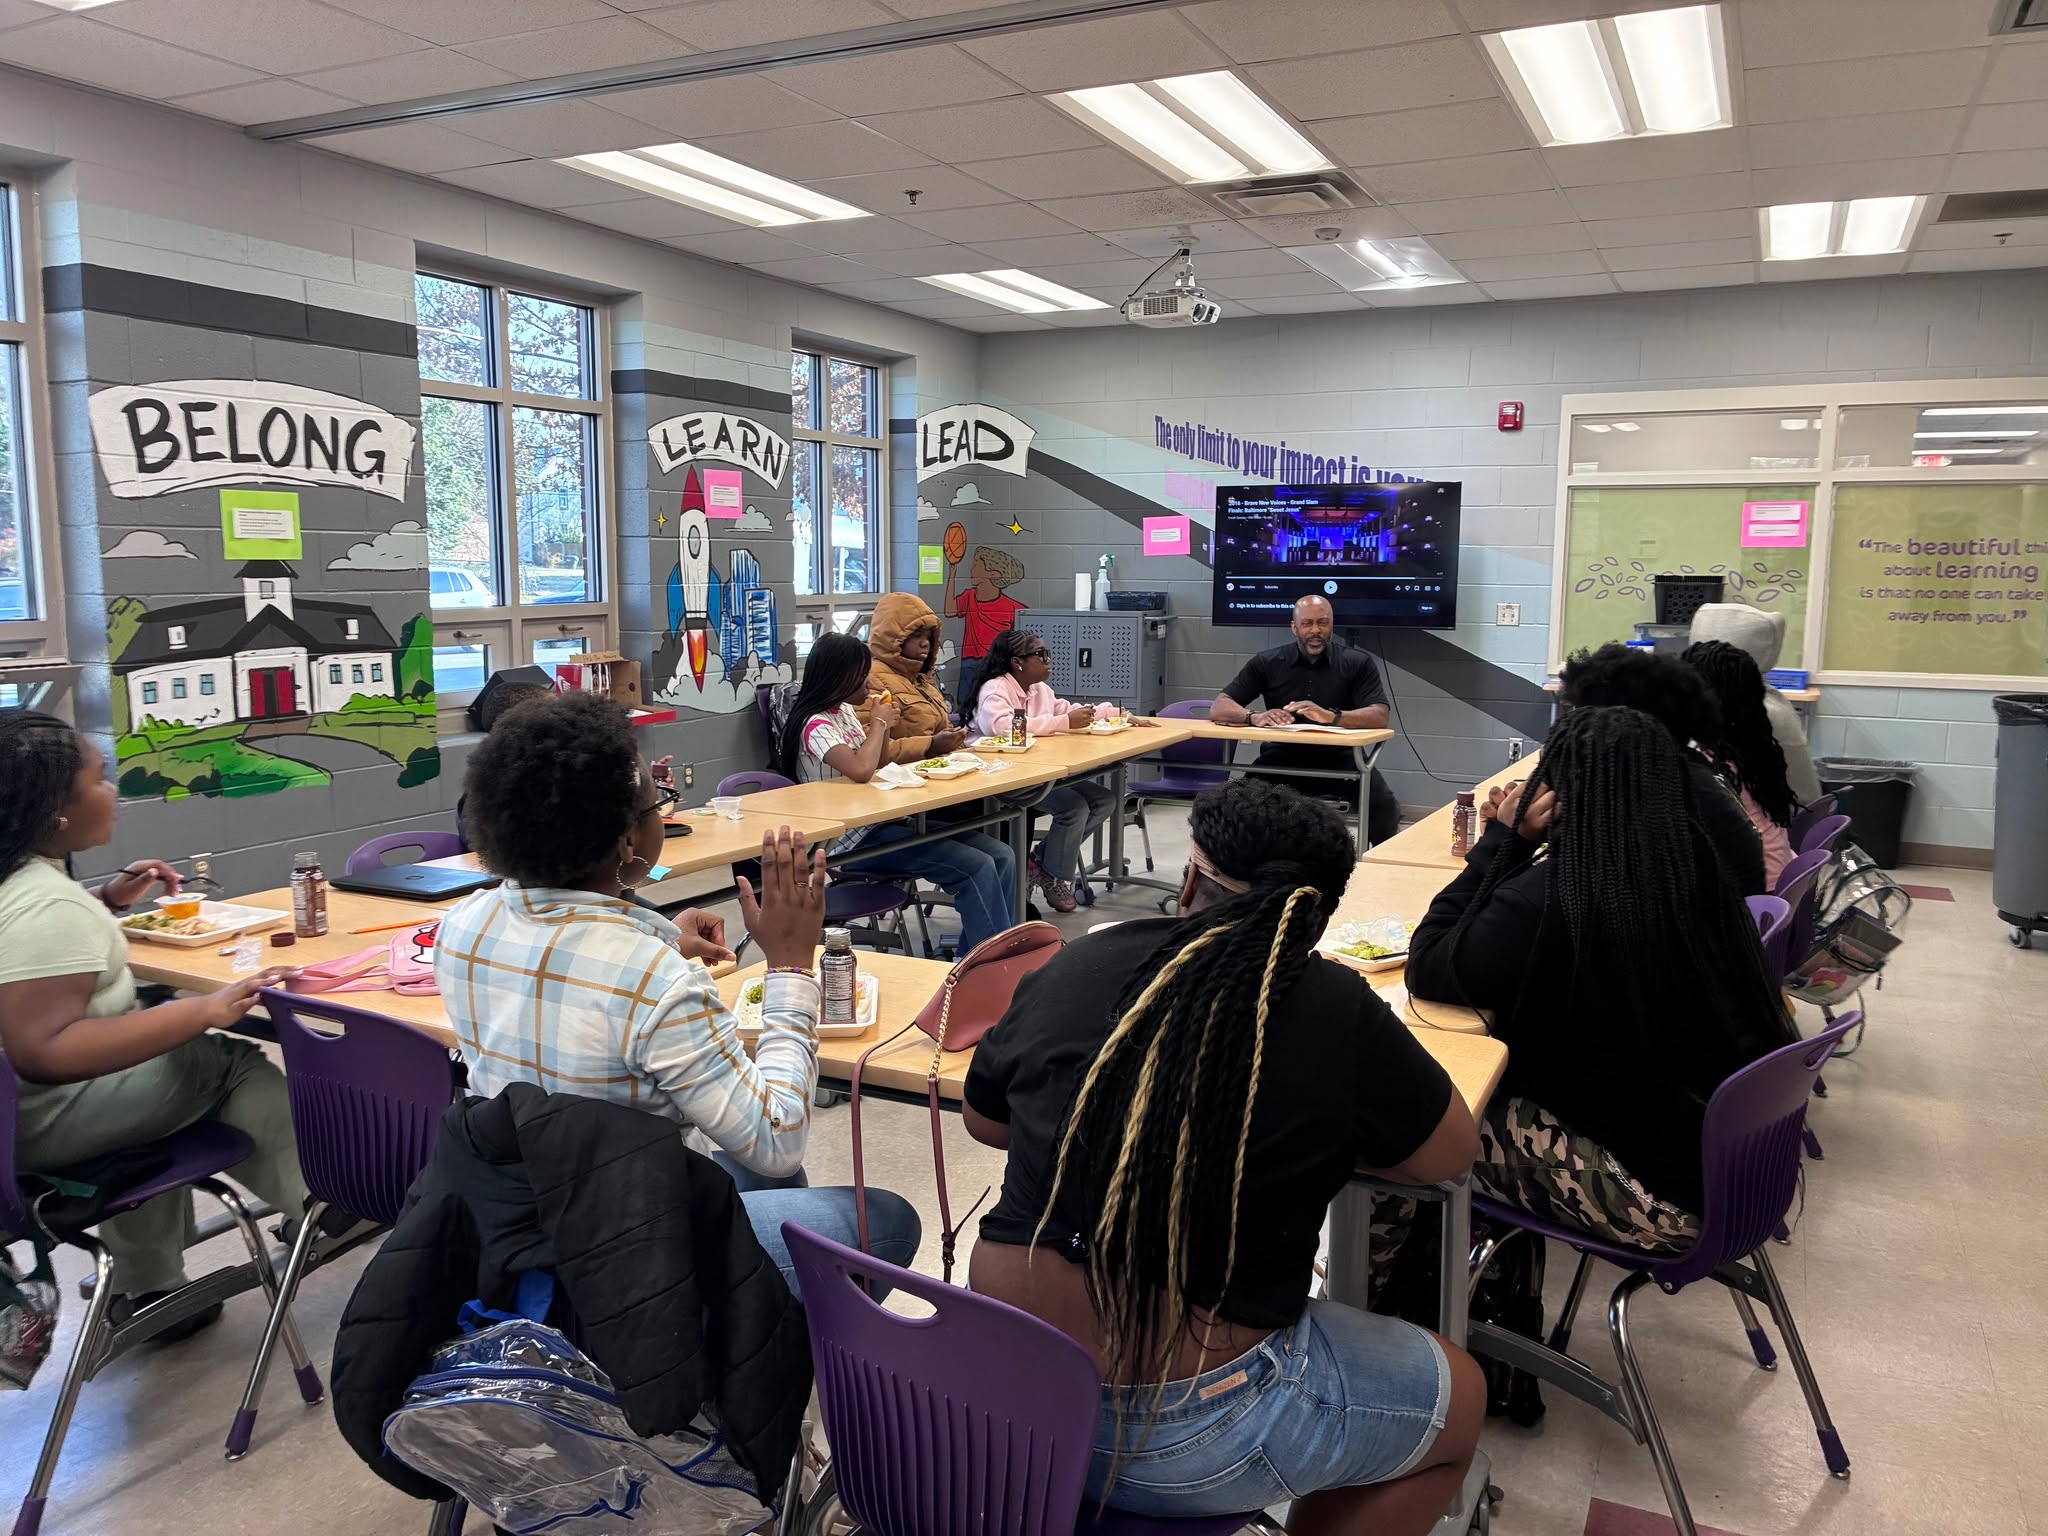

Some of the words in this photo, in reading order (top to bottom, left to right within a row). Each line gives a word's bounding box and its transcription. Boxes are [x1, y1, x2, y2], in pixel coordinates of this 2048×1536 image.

[121, 398, 386, 485] BELONG
[663, 416, 783, 480] LEARN
[923, 419, 1015, 468] LEAD
[1155, 415, 1172, 450] The
[1173, 421, 1195, 460] only
[1197, 424, 1225, 466] limit
[1227, 433, 1240, 470] to
[1242, 440, 1277, 479] your
[1280, 440, 1346, 484] impact
[1908, 538, 2021, 556] beautiful
[1883, 564, 1932, 576] about
[1936, 561, 2039, 583] learning
[1860, 586, 1874, 598] is
[1877, 587, 1911, 599] that
[1915, 589, 1935, 599] no
[1939, 589, 1971, 599] one
[1975, 589, 2003, 600] can
[2007, 588, 2044, 600] take
[1888, 611, 1929, 624] away
[1933, 610, 1971, 622] from
